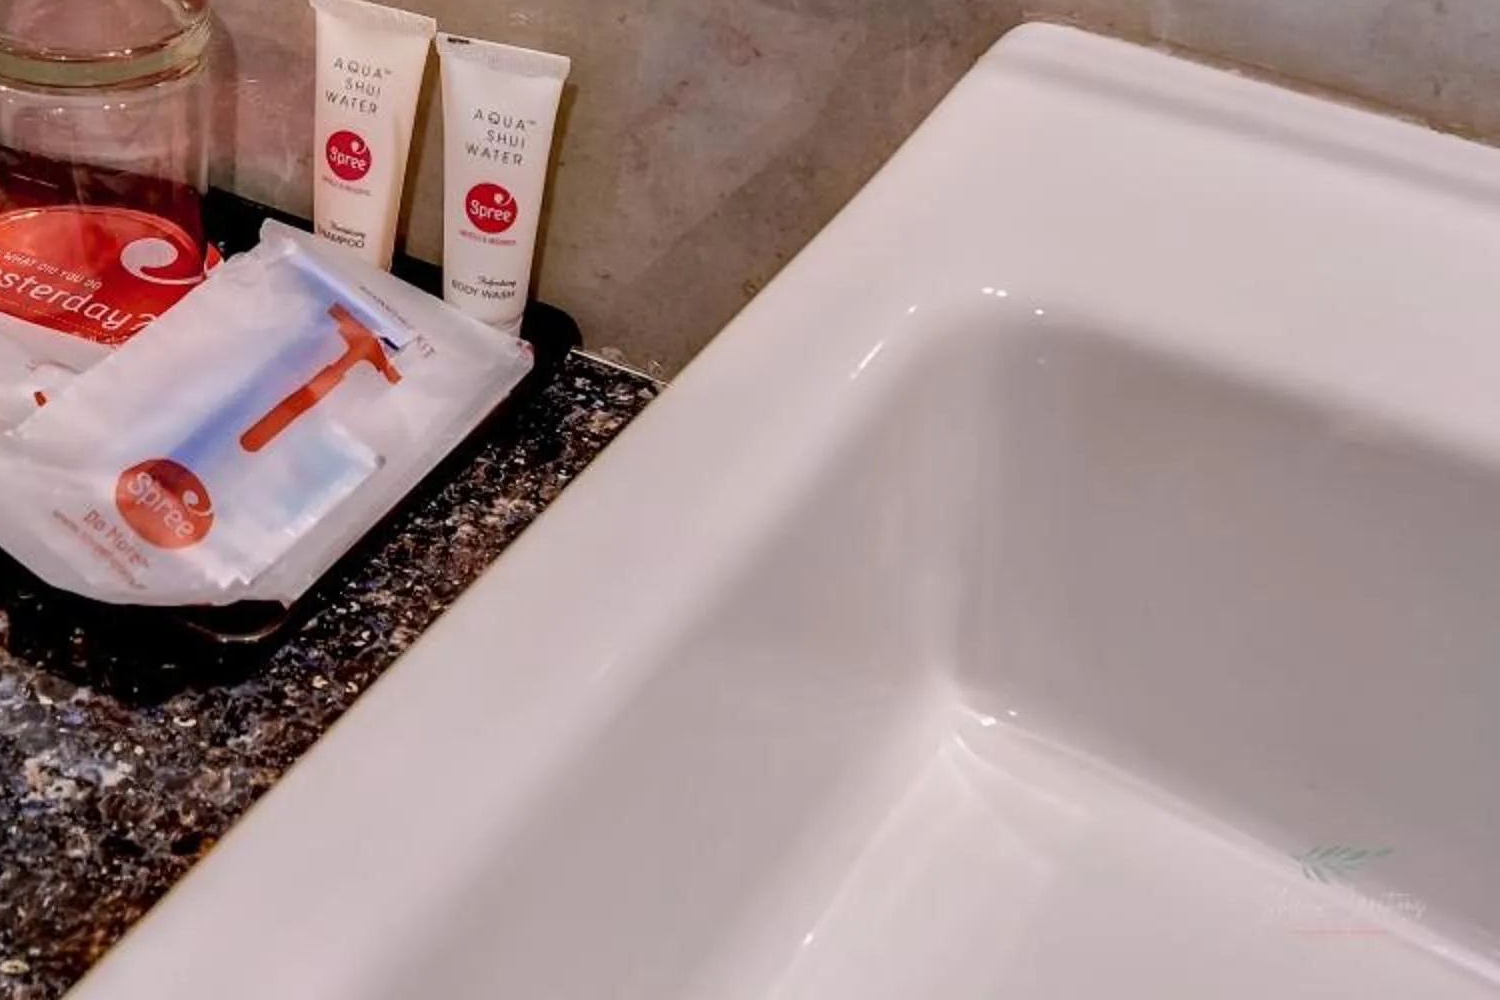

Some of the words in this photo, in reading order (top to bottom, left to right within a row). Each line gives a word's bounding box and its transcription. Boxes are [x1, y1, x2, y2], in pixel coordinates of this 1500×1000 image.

[345, 77, 381, 99] SHUI
[325, 89, 377, 115] WATER
[487, 129, 524, 150] SHUI
[329, 145, 367, 171] Spree
[464, 141, 524, 166] WATER
[469, 199, 513, 224] Spree
[127, 471, 196, 539] Spree
